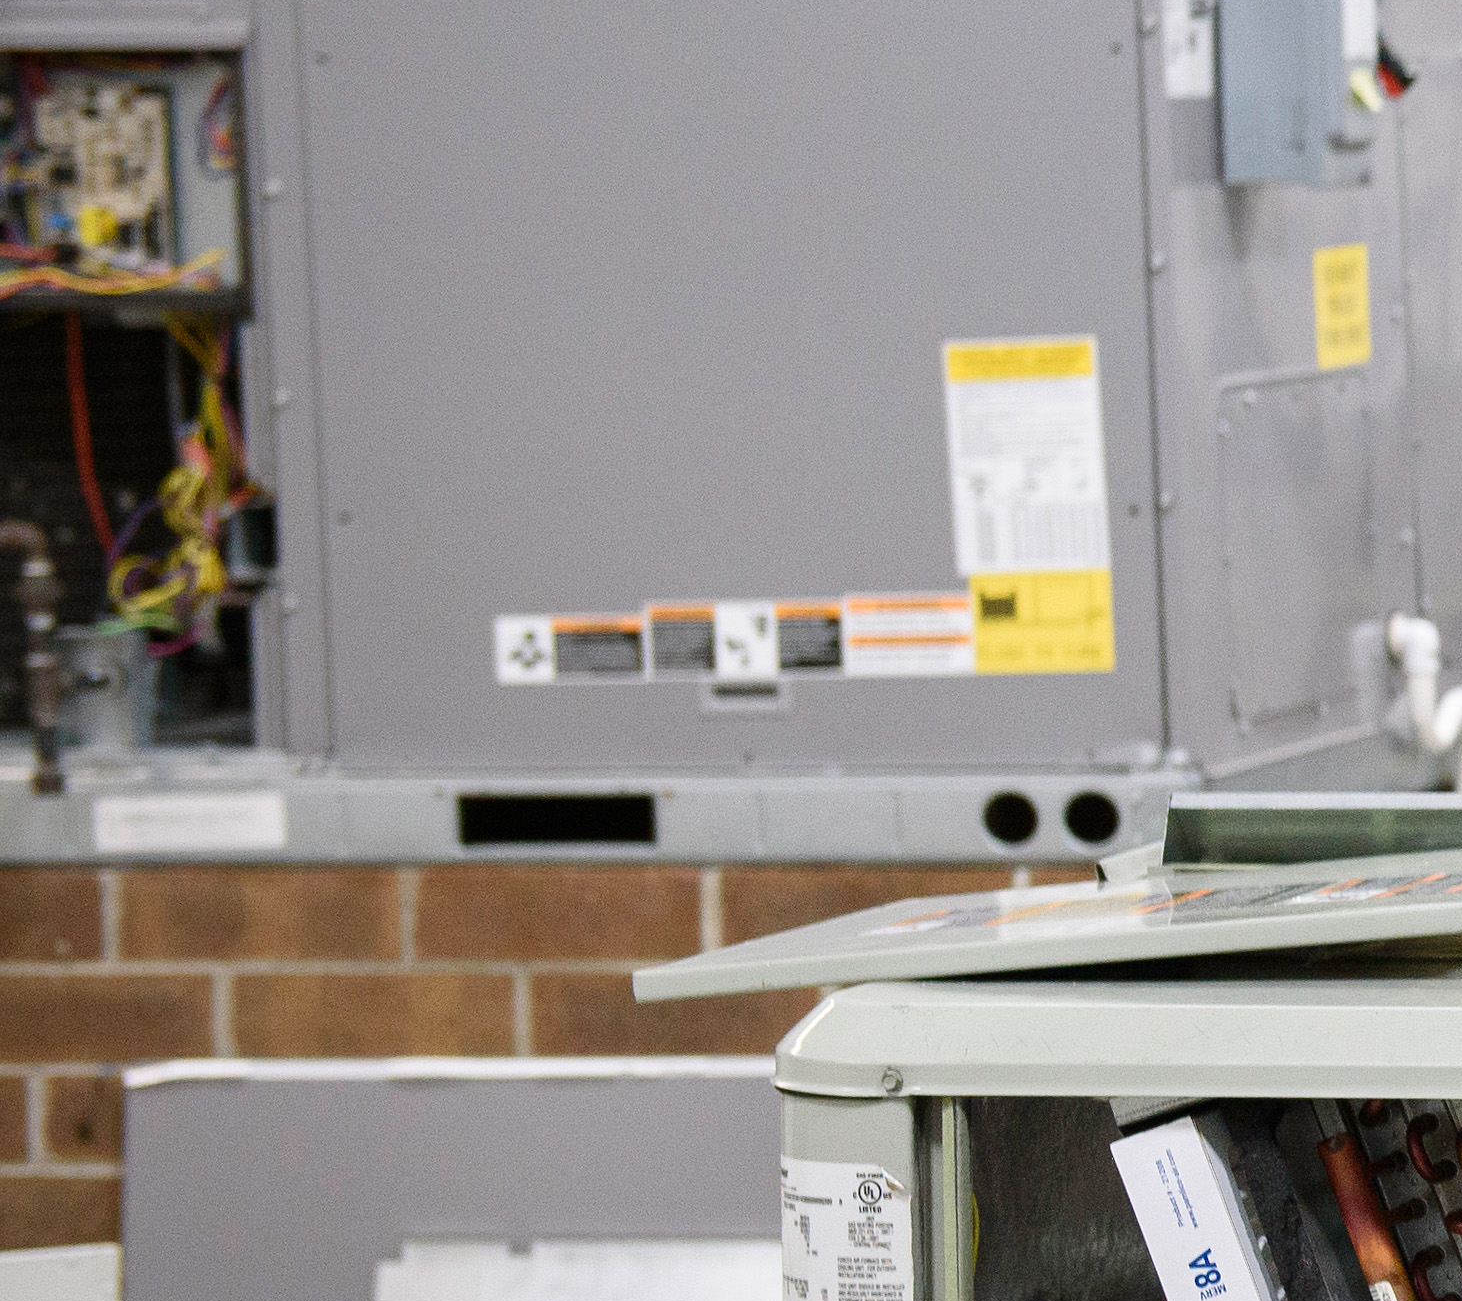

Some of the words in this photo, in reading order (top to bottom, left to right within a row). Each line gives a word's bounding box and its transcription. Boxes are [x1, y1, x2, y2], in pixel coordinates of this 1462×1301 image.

[858, 1205, 882, 1214] LISTED
[1188, 1247, 1221, 1289] 8A
[1199, 1284, 1227, 1301] MERV
